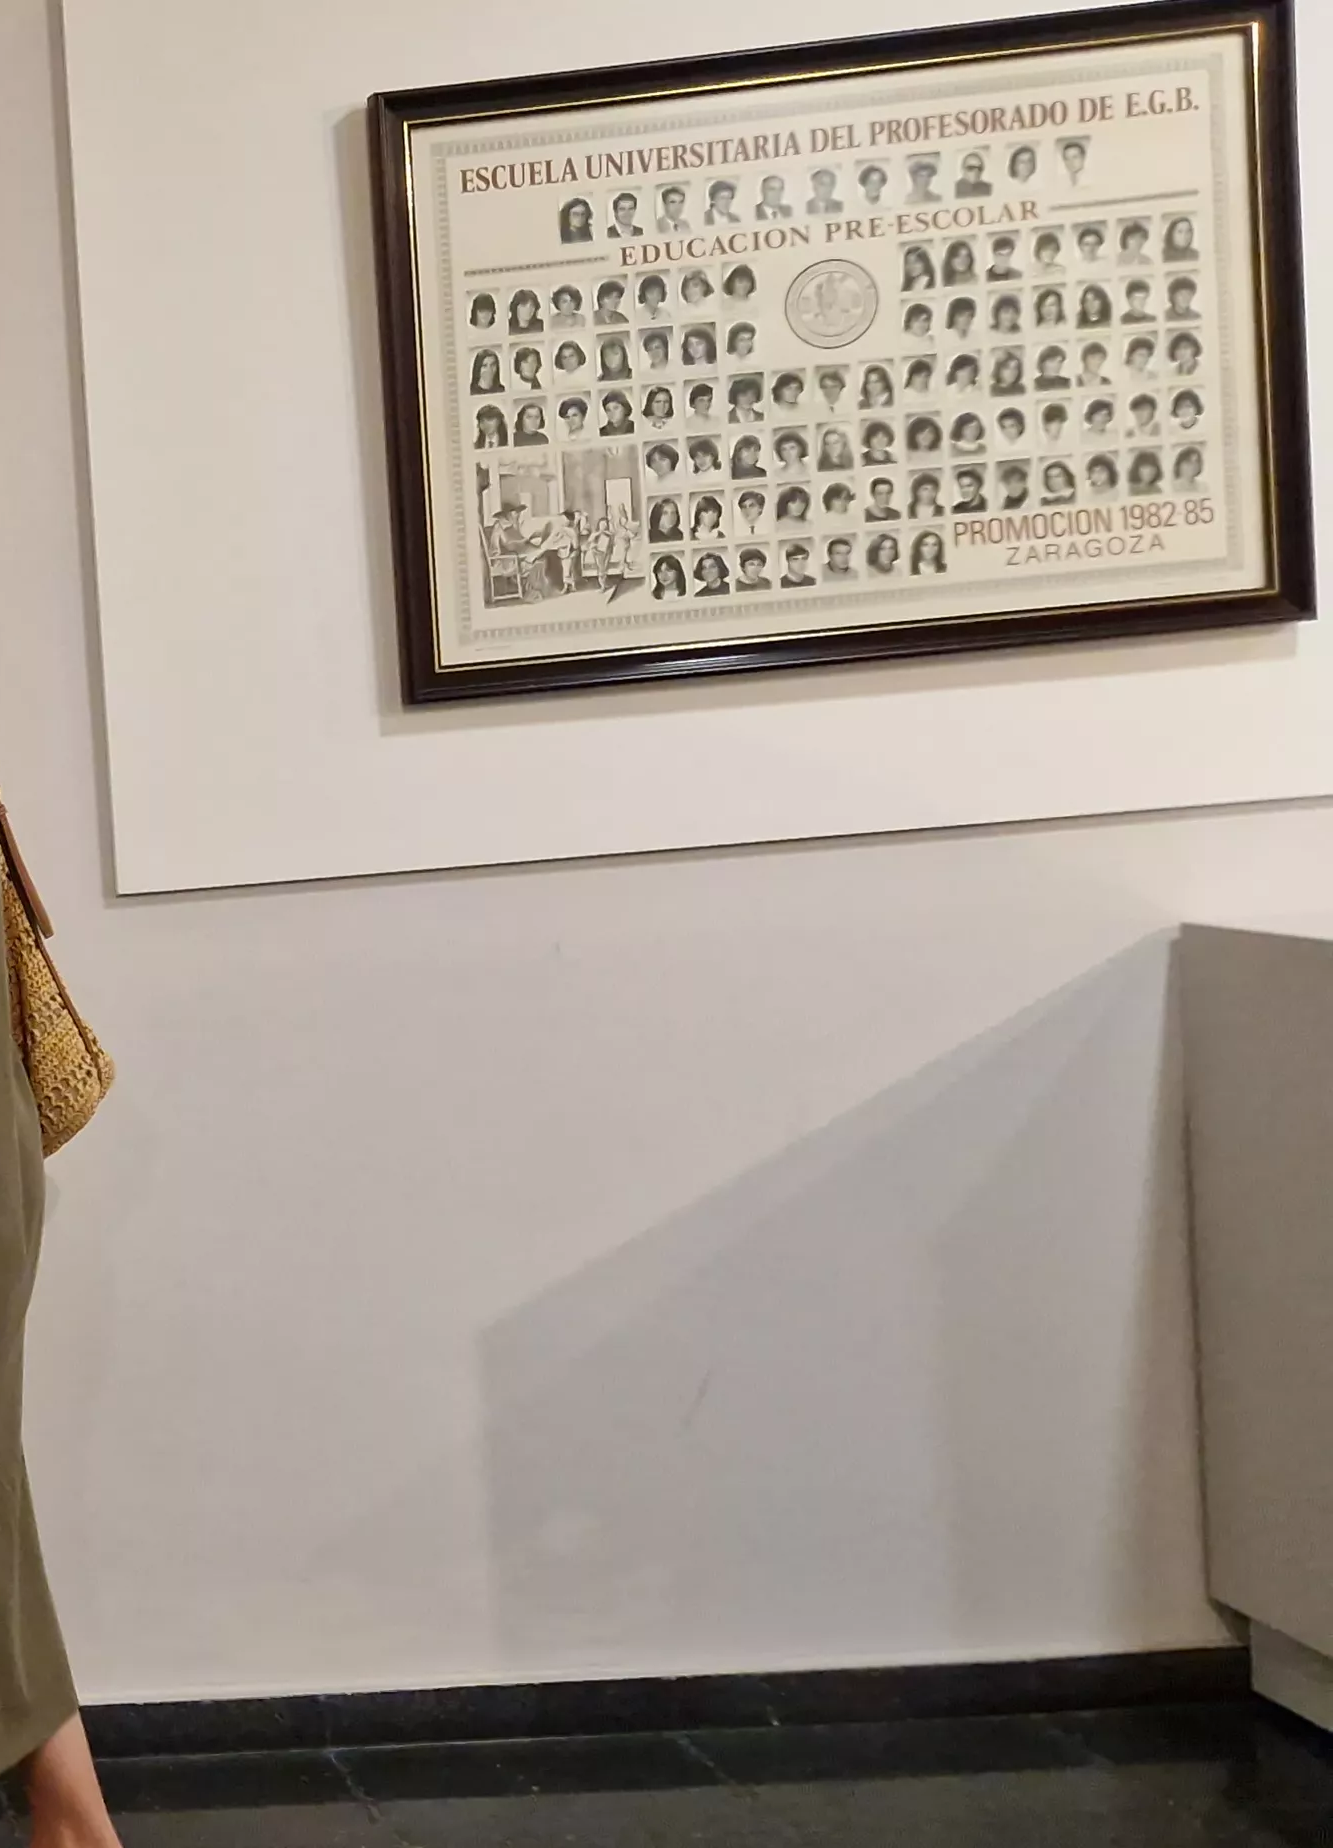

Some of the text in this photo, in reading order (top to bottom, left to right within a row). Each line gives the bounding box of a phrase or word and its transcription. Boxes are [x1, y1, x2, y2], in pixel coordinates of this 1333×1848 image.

[460, 86, 1200, 194] ESCUELA UNIVERSITARIA DEL PROFESORADO DE E.G.B.
[620, 200, 1040, 267] EDUCACION PRE-ESCOLAR
[954, 508, 1113, 548] PROMOCION
[1006, 533, 1166, 566] ZARAGOZA
